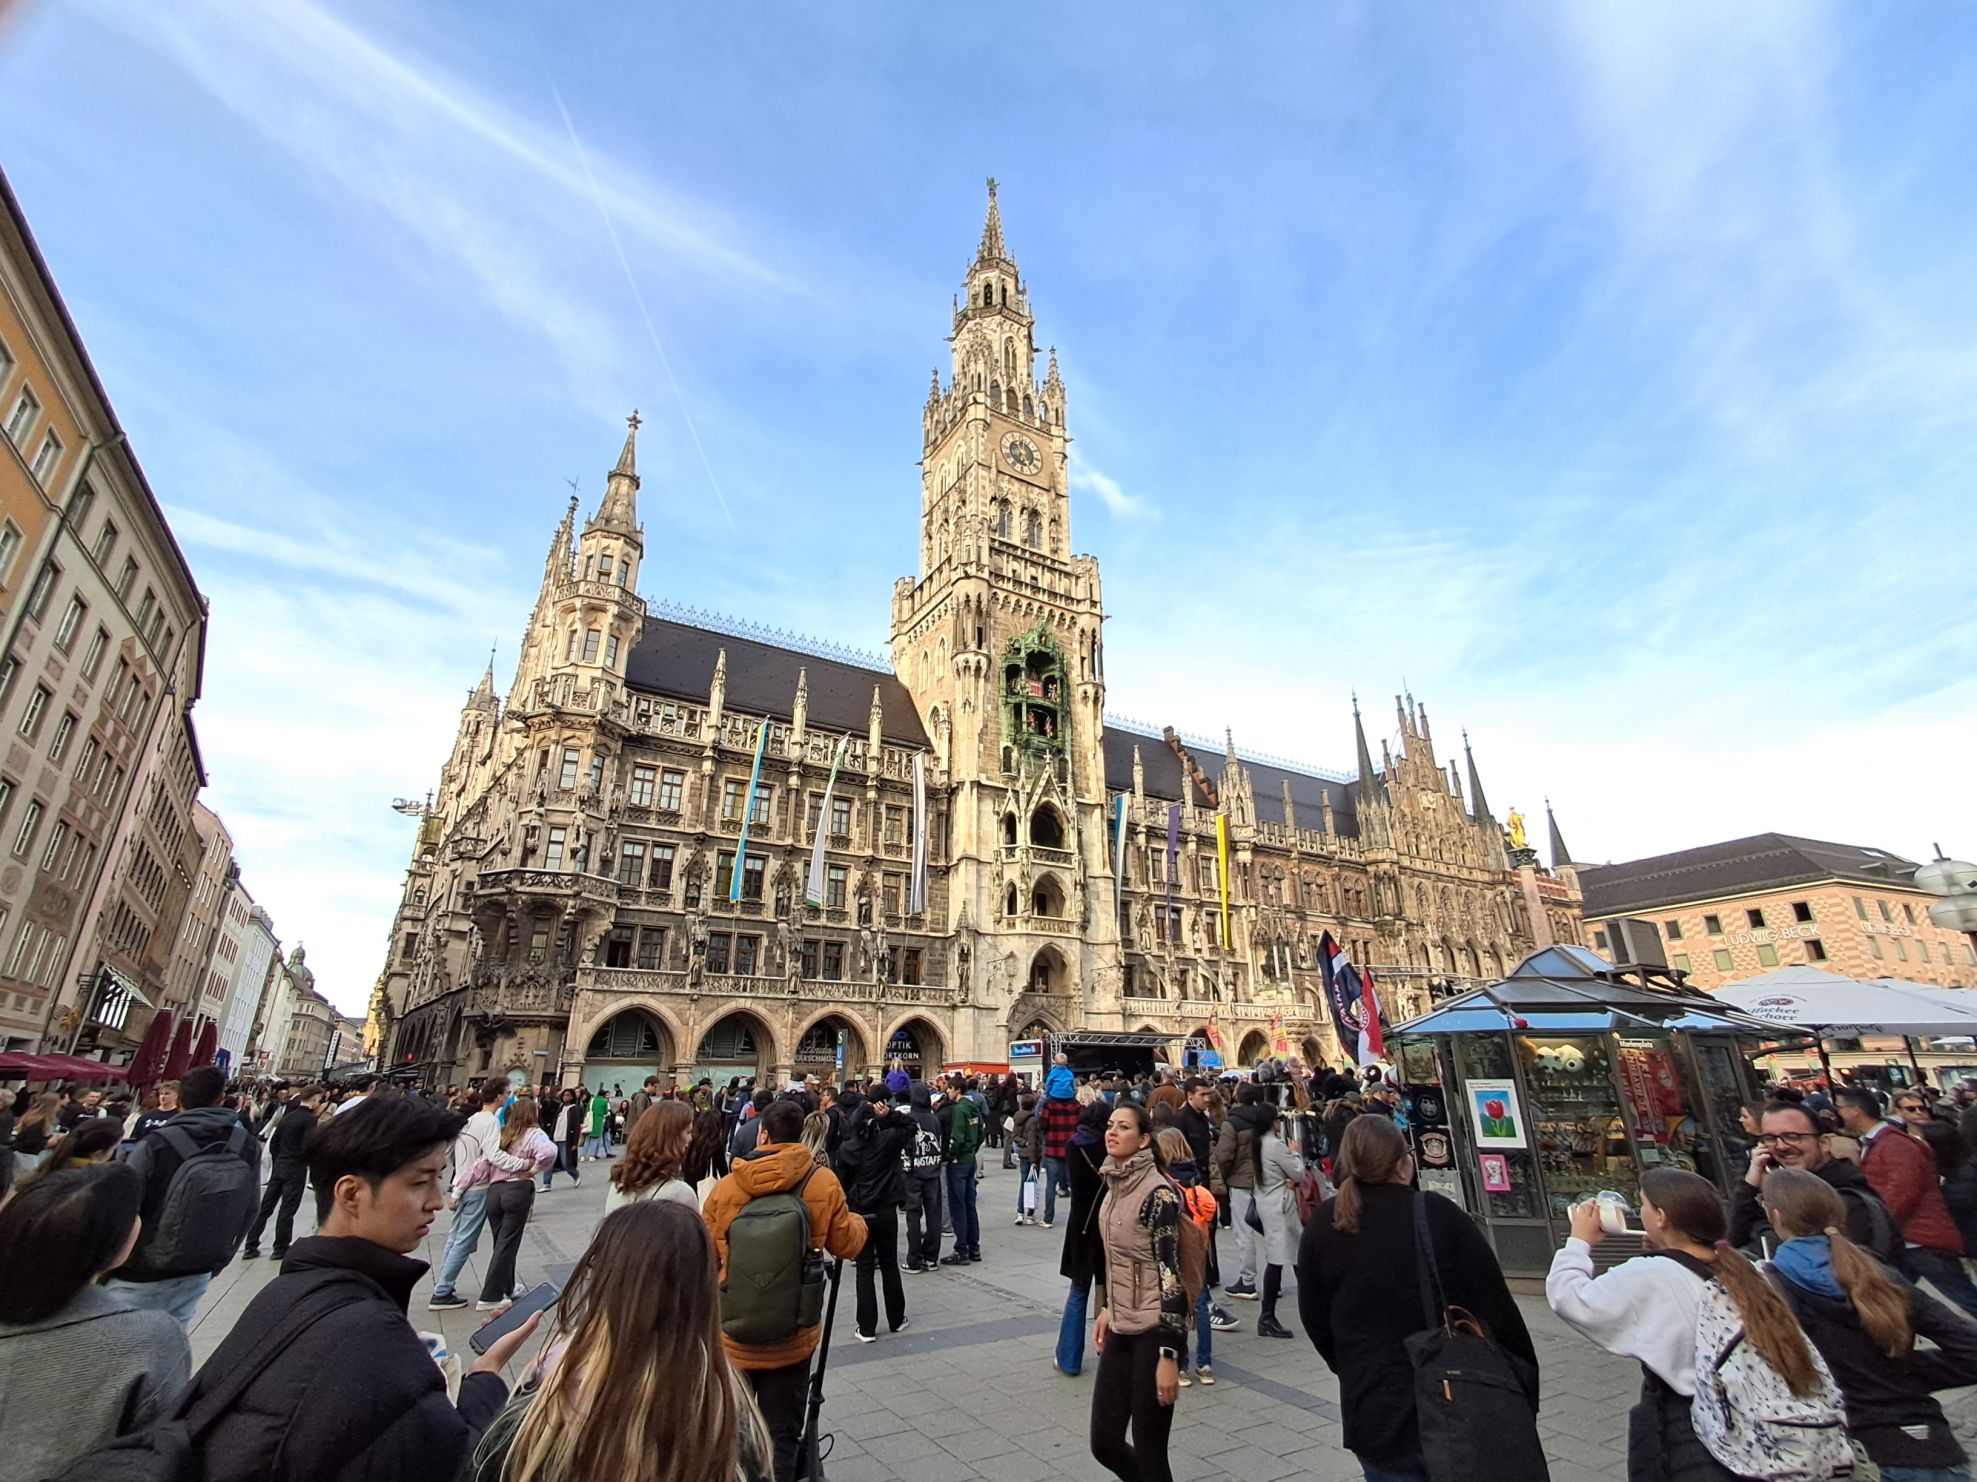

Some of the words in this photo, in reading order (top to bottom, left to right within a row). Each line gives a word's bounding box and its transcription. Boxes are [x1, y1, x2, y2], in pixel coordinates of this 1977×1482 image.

[1723, 930, 1779, 946] LUDWIG
[1780, 924, 1822, 939] BECK
[837, 1031, 843, 1044] S
